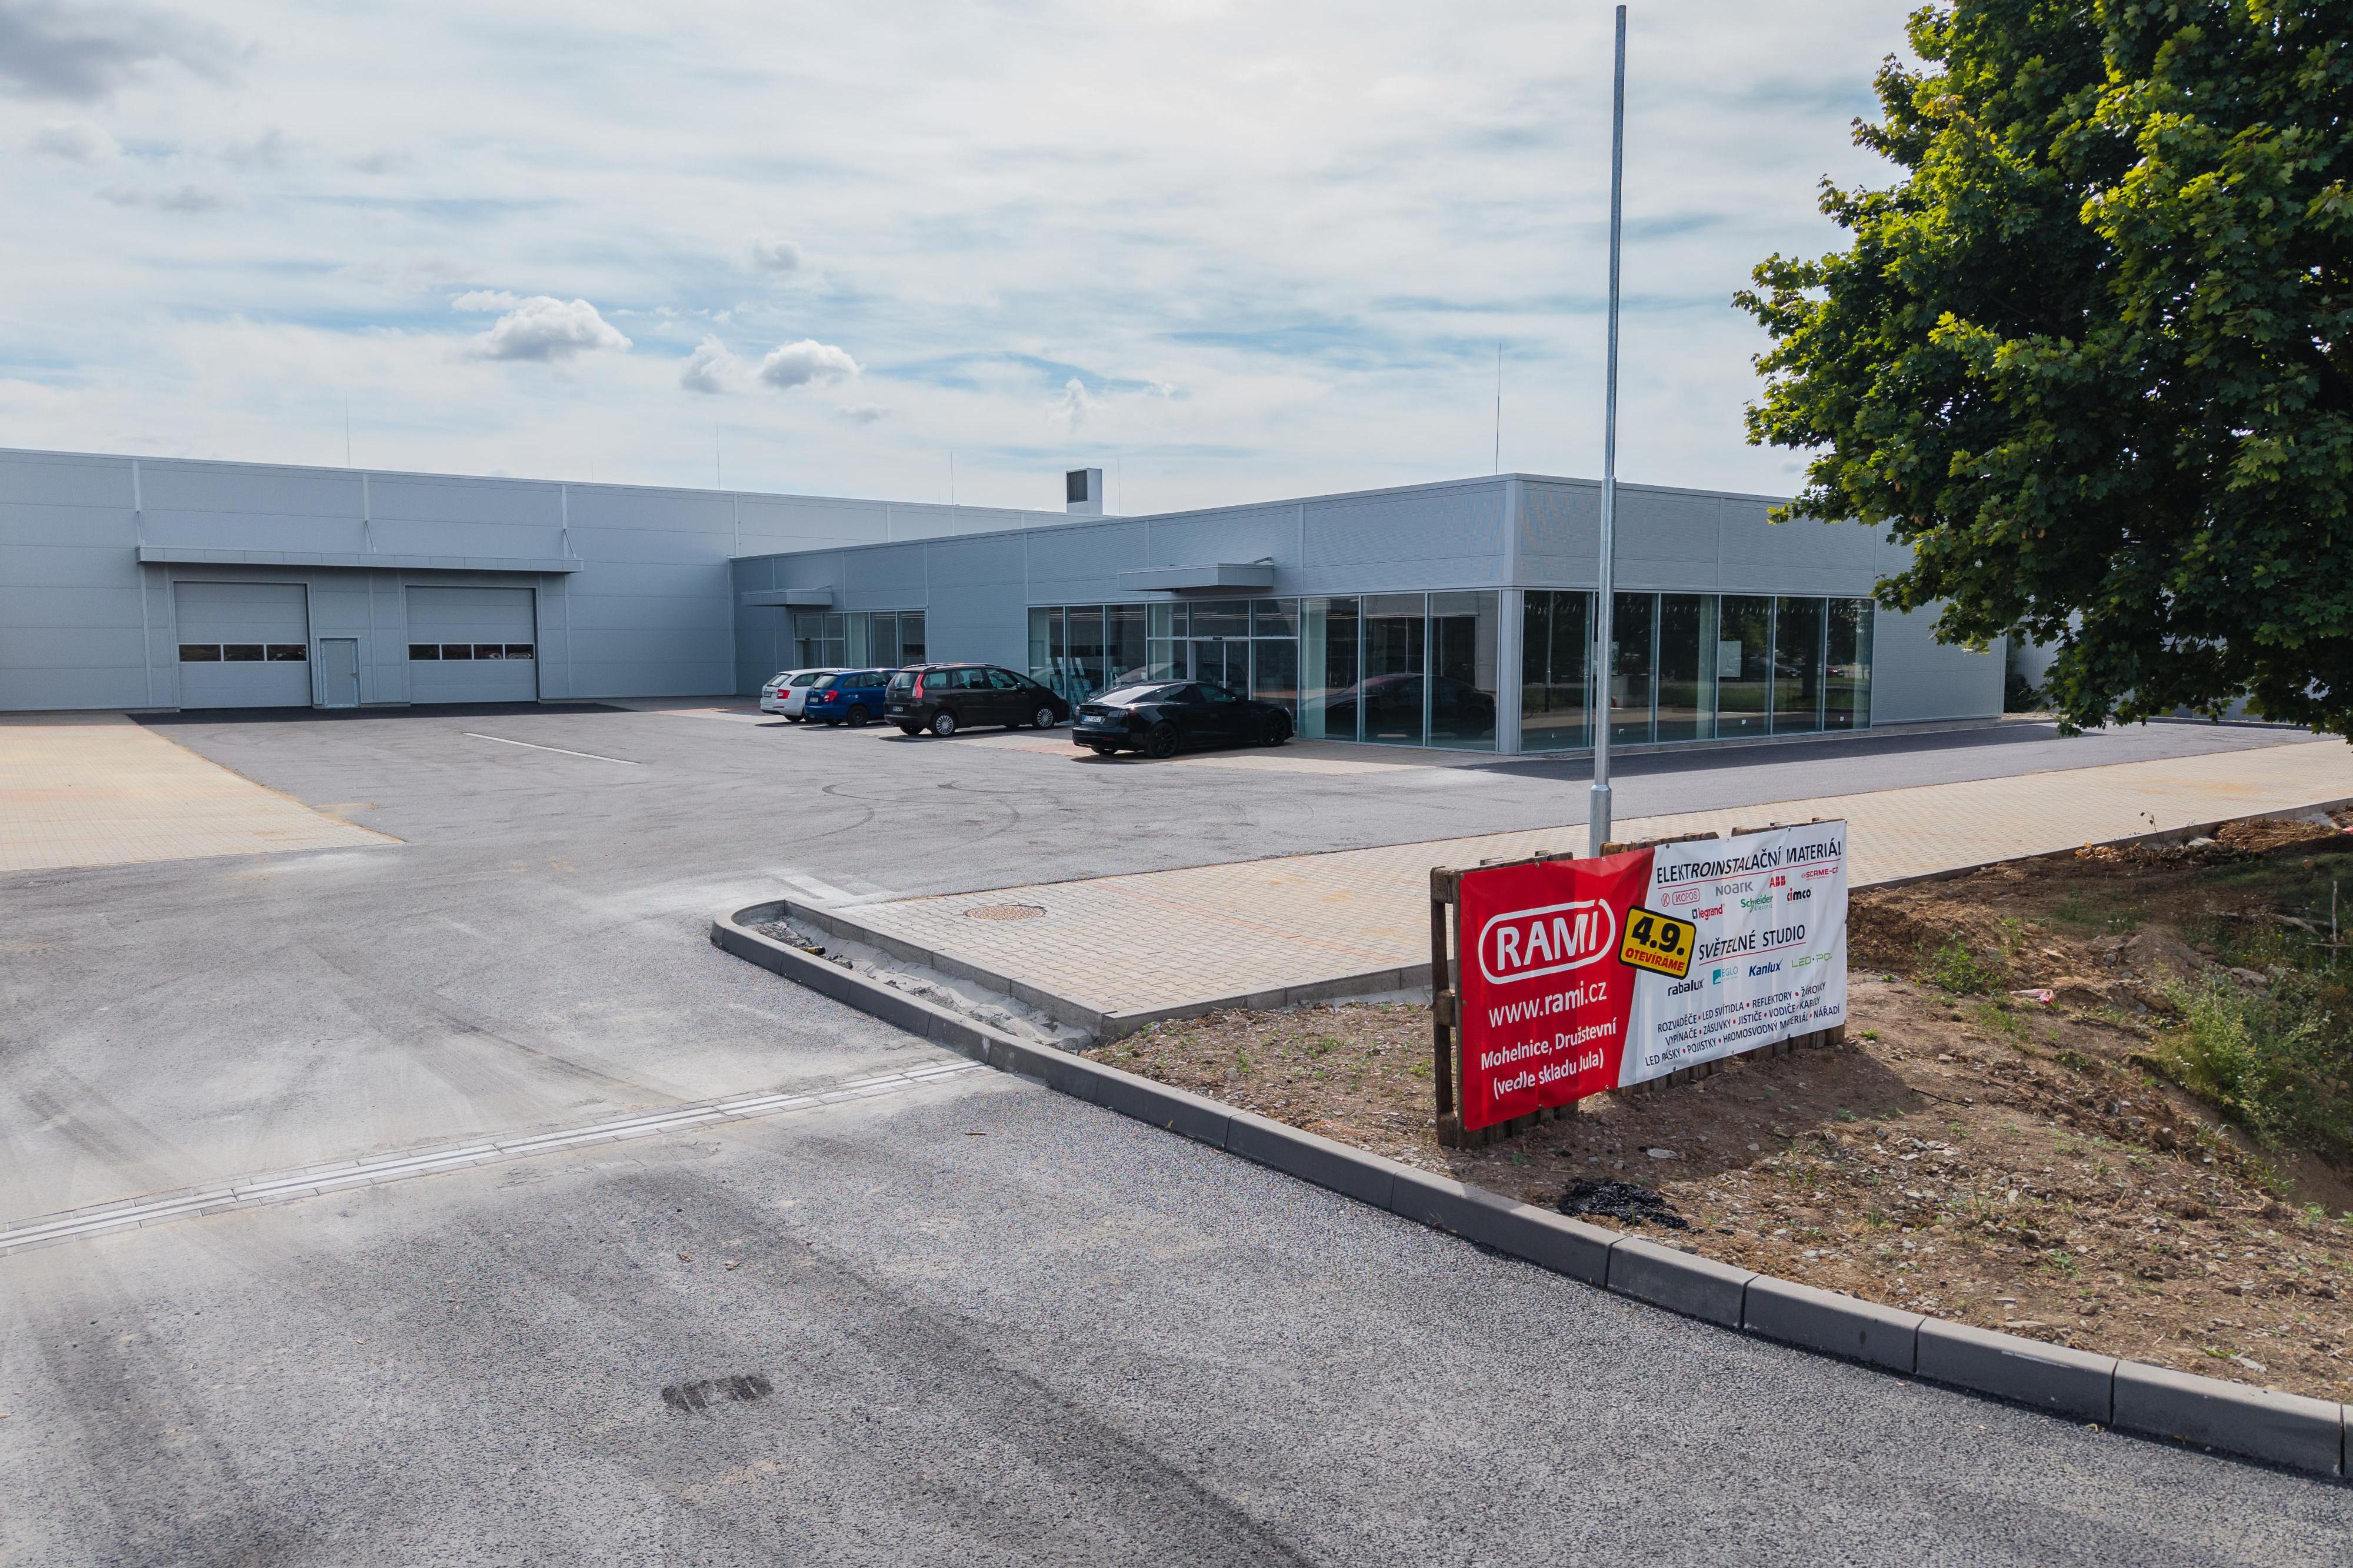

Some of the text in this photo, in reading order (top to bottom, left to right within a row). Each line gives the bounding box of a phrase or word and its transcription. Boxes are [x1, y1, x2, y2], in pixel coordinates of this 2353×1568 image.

[1657, 838, 1842, 883] ELEKTROINSTALAČNÍ MATERIÁL
[1675, 891, 1698, 903] KOPOS
[1769, 875, 1786, 888] ABB
[1787, 888, 1811, 902] cimco
[1698, 903, 1723, 920] legrand
[1497, 911, 1598, 970] RAMI
[1631, 916, 1685, 956] 4.9.
[1698, 924, 1805, 960] SVĚTELNÉ STUDIO
[1625, 947, 1685, 972] OTEVÍRÁME
[1722, 966, 1738, 977] EGLO
[1748, 958, 1783, 977] Kanlux
[1489, 980, 1607, 1027] www.rami.cz
[1668, 979, 1704, 996] rabalux
[1658, 1013, 1697, 1033] ROZVADĚČE
[1702, 1009, 1714, 1020] LED
[1715, 1002, 1744, 1017] SVÍTIDLA
[1752, 991, 1792, 1008] REFLEKTORY
[1665, 1026, 1697, 1046] VYPÍNAČE
[1704, 1019, 1731, 1035] ZÁSUVKY
[1738, 1011, 1762, 1025] JISTIČE
[1769, 1003, 1795, 1018] VODIČE
[1481, 1017, 1617, 1070] Mohelnice, Družstevní
[1645, 1003, 1840, 1066] LED PÁSKY POJISTKY HROMOSVODNÝ MATERIÁL NÁŘADÍ
[1493, 1048, 1604, 1100] (vedle skladu Jula)
